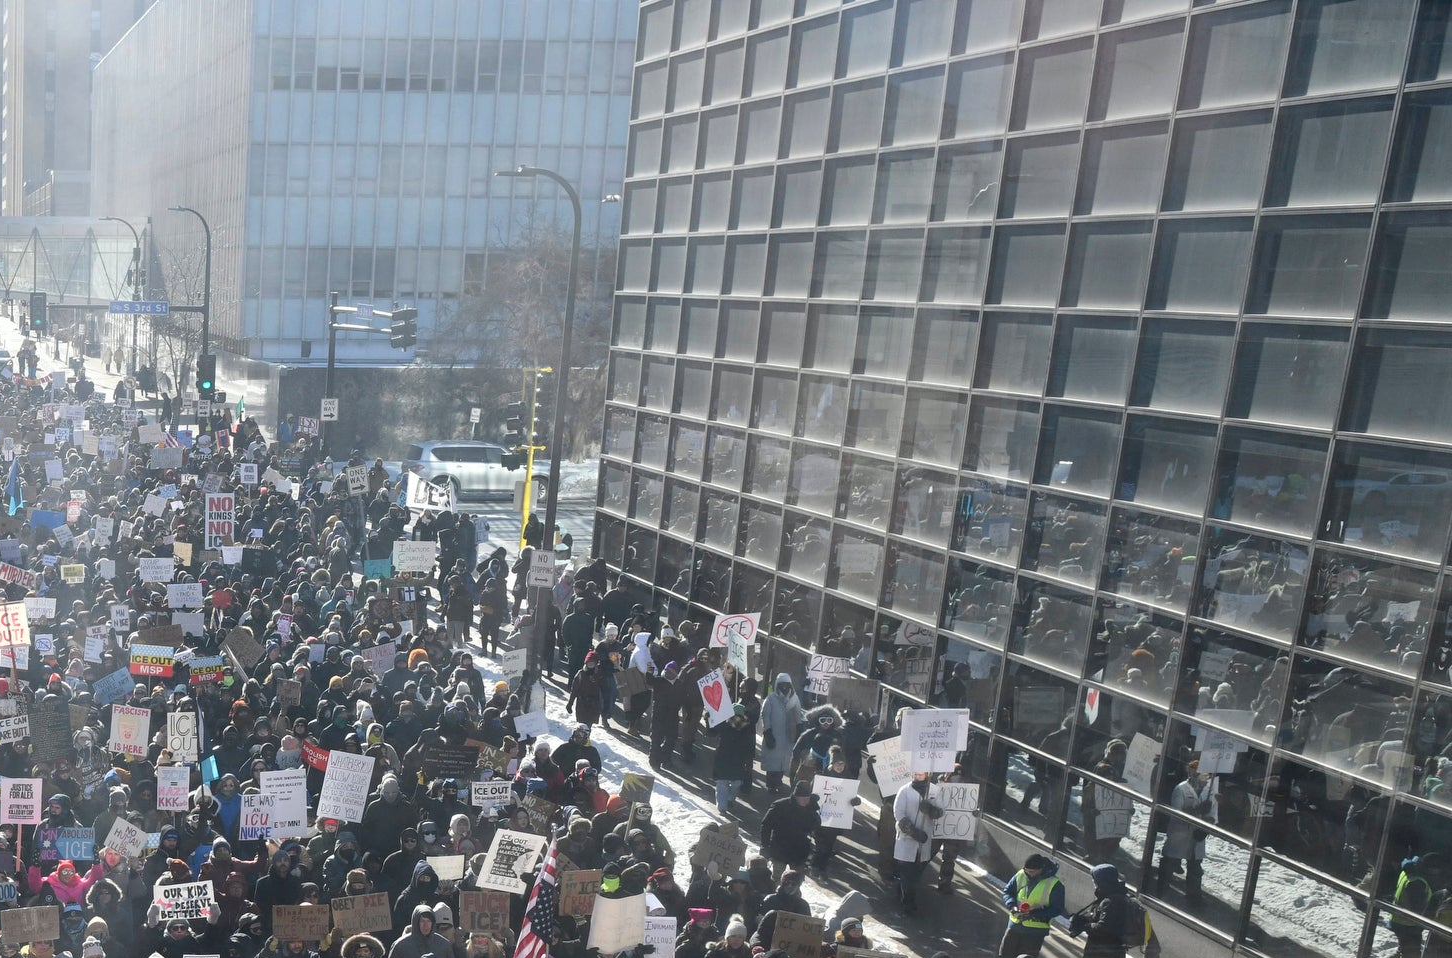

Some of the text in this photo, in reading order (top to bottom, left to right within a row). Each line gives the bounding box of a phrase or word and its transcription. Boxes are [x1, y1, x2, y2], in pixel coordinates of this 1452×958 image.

[348, 468, 364, 476] ONE
[349, 475, 366, 484] WAY
[208, 497, 233, 511] NO
[208, 512, 232, 520] KINGS
[208, 522, 232, 535] NO
[538, 554, 548, 563] NO
[531, 565, 554, 574] STOPPING
[132, 655, 173, 666] ICE OUT
[140, 665, 163, 675] MSP
[198, 673, 216, 681] MSP
[113, 706, 148, 717] FASCISM
[114, 743, 142, 754] IS HERE
[474, 786, 508, 795] ICE OUT
[243, 795, 276, 807] HE WAS
[245, 813, 269, 826] ICU
[240, 826, 272, 839] NURSE
[65, 841, 92, 858] ICE
[164, 884, 208, 899] OUR KIDS
[176, 898, 212, 910] DESERVE
[161, 910, 202, 919] BETTER
